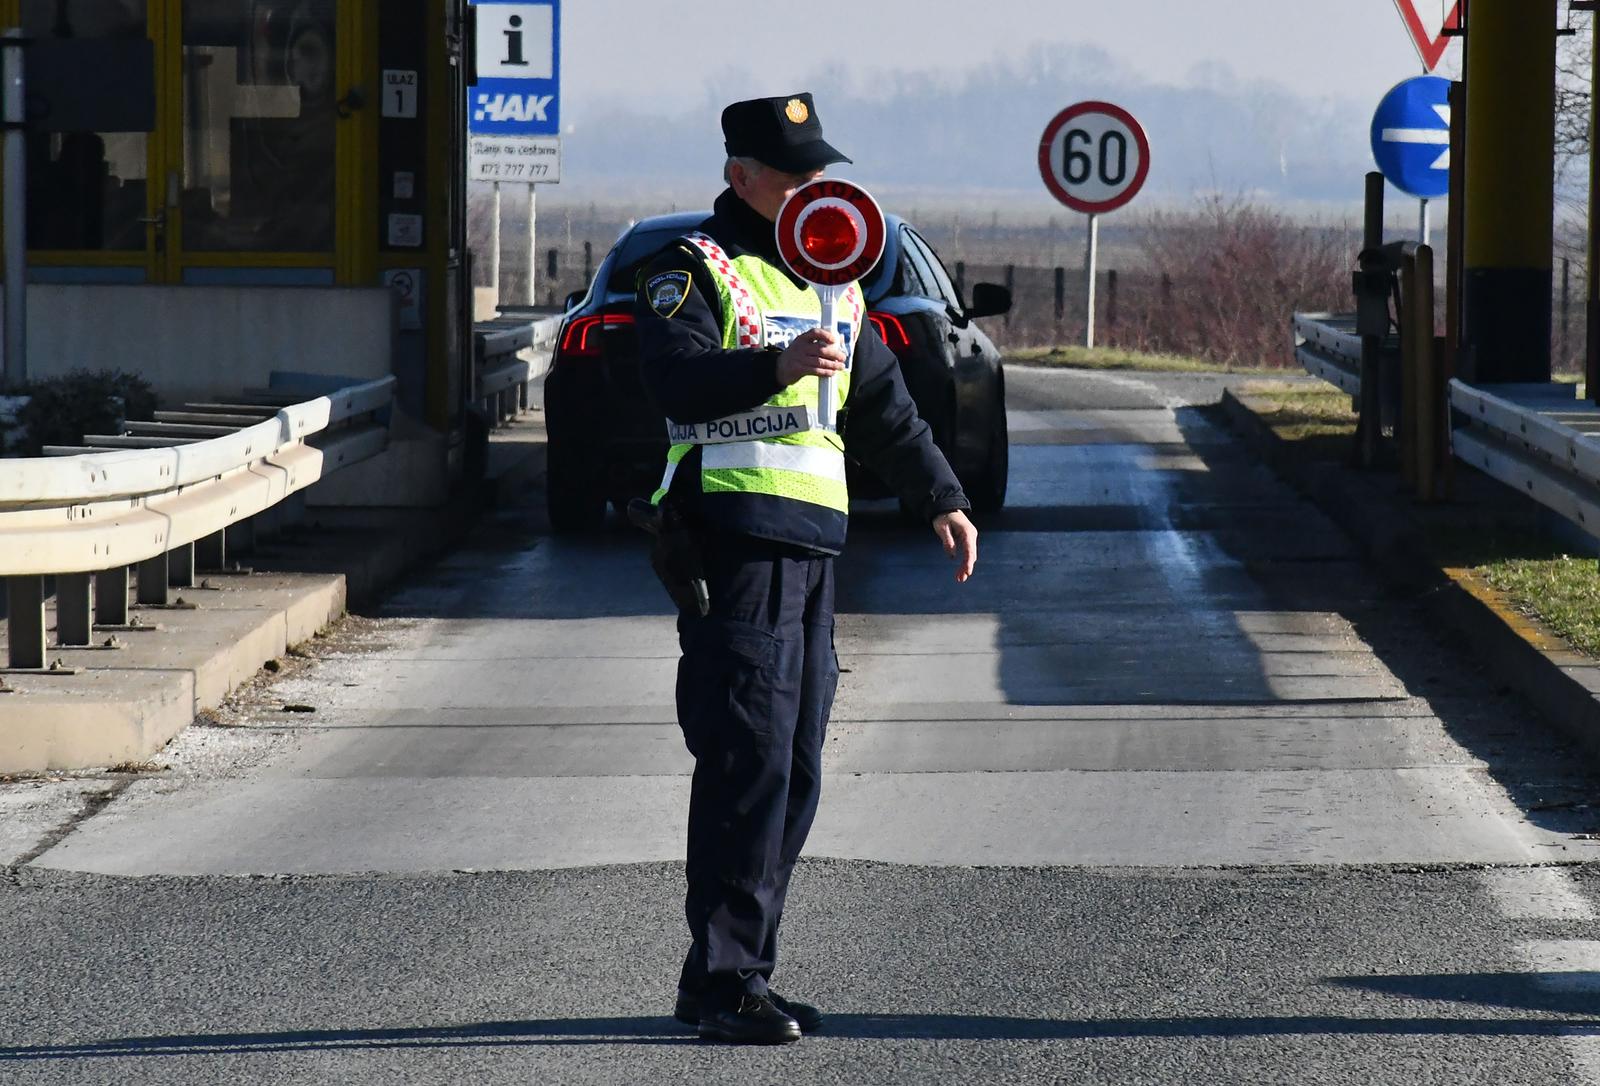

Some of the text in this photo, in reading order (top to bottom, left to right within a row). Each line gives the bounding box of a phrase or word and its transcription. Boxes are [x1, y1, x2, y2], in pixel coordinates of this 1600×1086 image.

[395, 90, 403, 113] 1
[474, 93, 554, 122] HAK
[1063, 129, 1127, 186] 60
[800, 181, 865, 203] STOP
[649, 274, 688, 288] POLICIJA
[790, 256, 875, 285] POLICIJA
[706, 411, 799, 439] POLICIJA
